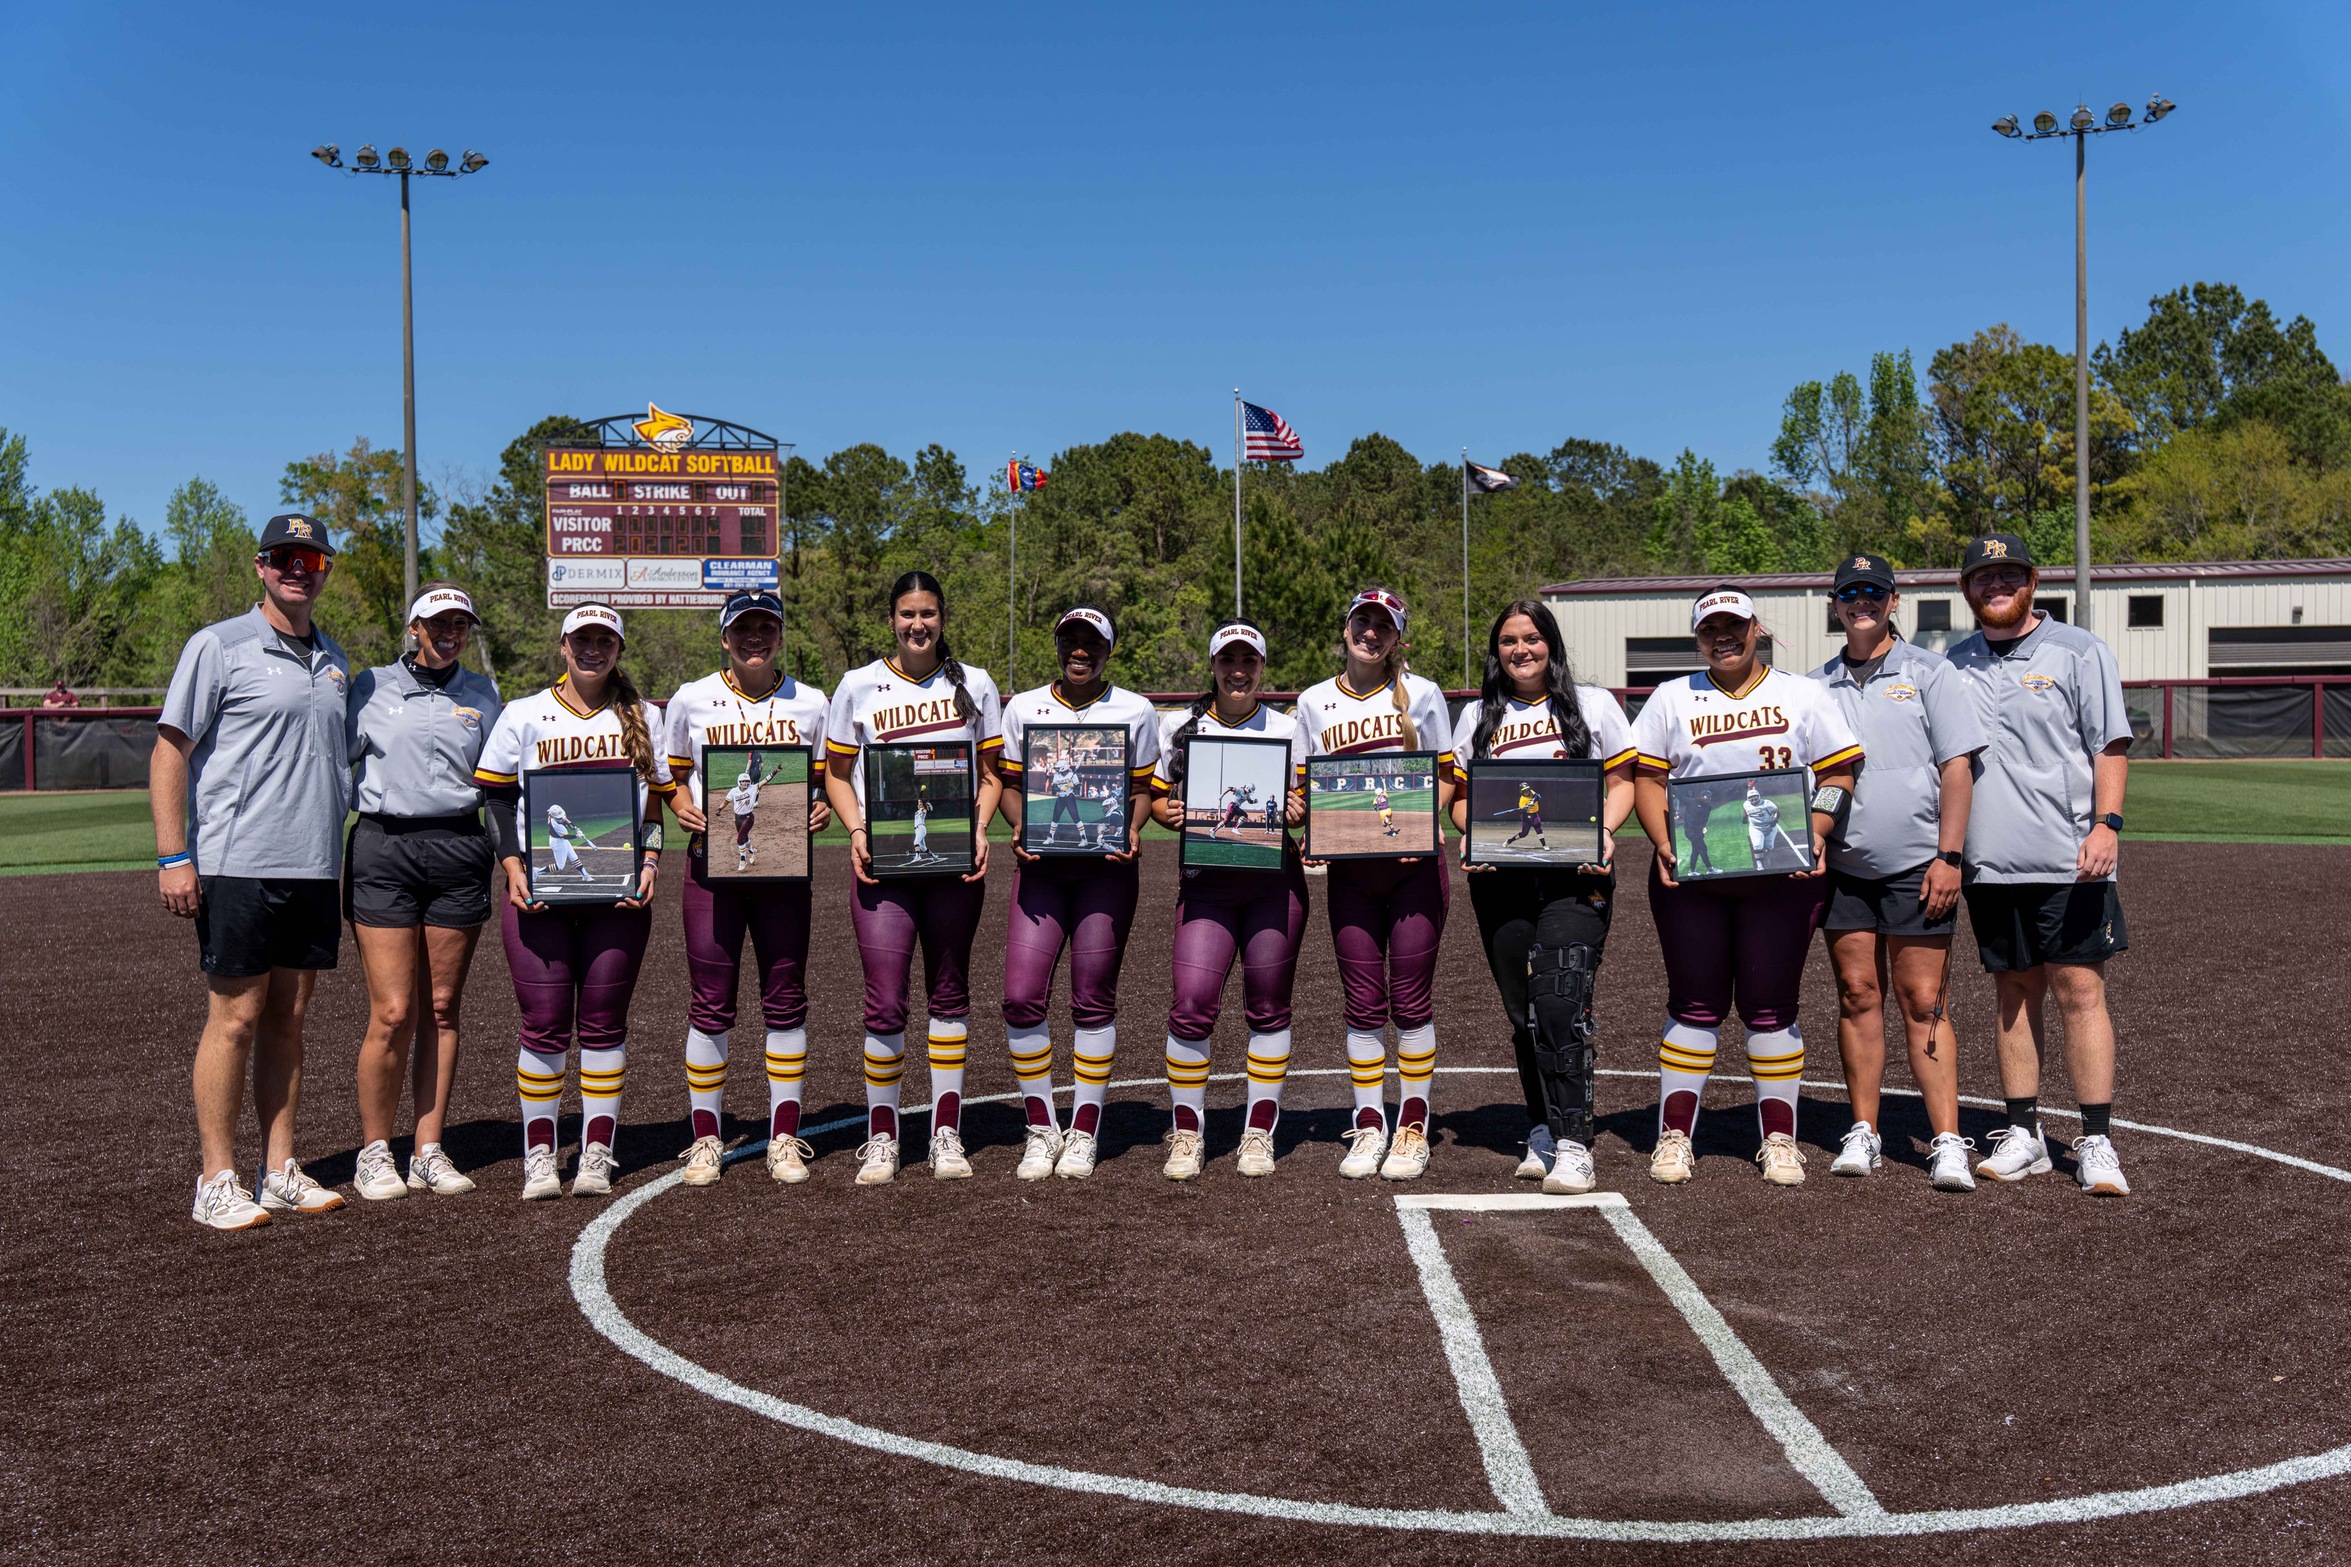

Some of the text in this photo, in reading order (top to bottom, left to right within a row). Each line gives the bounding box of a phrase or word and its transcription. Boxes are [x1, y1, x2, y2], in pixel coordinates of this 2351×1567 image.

[549, 453, 775, 474] LADY WILDCAT SOFTBALL
[569, 484, 612, 499] BALL
[634, 485, 691, 499] STRIKE
[716, 486, 749, 500] OUT
[617, 506, 767, 516] 1 2 3 4 5 6 7 TOTAL
[286, 519, 312, 539] PR
[552, 517, 612, 532] VISITOR
[561, 537, 603, 552] PRCC
[1982, 539, 2008, 559] PR
[709, 561, 772, 569] CLEARMAN
[1852, 557, 1872, 570] PR
[568, 568, 622, 579] DERMIX
[430, 593, 452, 603] PEARL
[552, 594, 725, 605] SCOREBOARD PROVIDED BY HATTIESBURG
[1699, 596, 1739, 612] PEARL RIVER
[577, 609, 618, 624] PEARL RIVER
[1084, 612, 1103, 624] RIVER
[1220, 628, 1257, 640] PEARL RIVER
[1689, 705, 1783, 737] WILDCATS
[705, 719, 797, 745] WILDCATS
[1320, 713, 1403, 753] WILDCATS
[1490, 717, 1562, 747] WILDCA
[1759, 746, 1792, 770] 33
